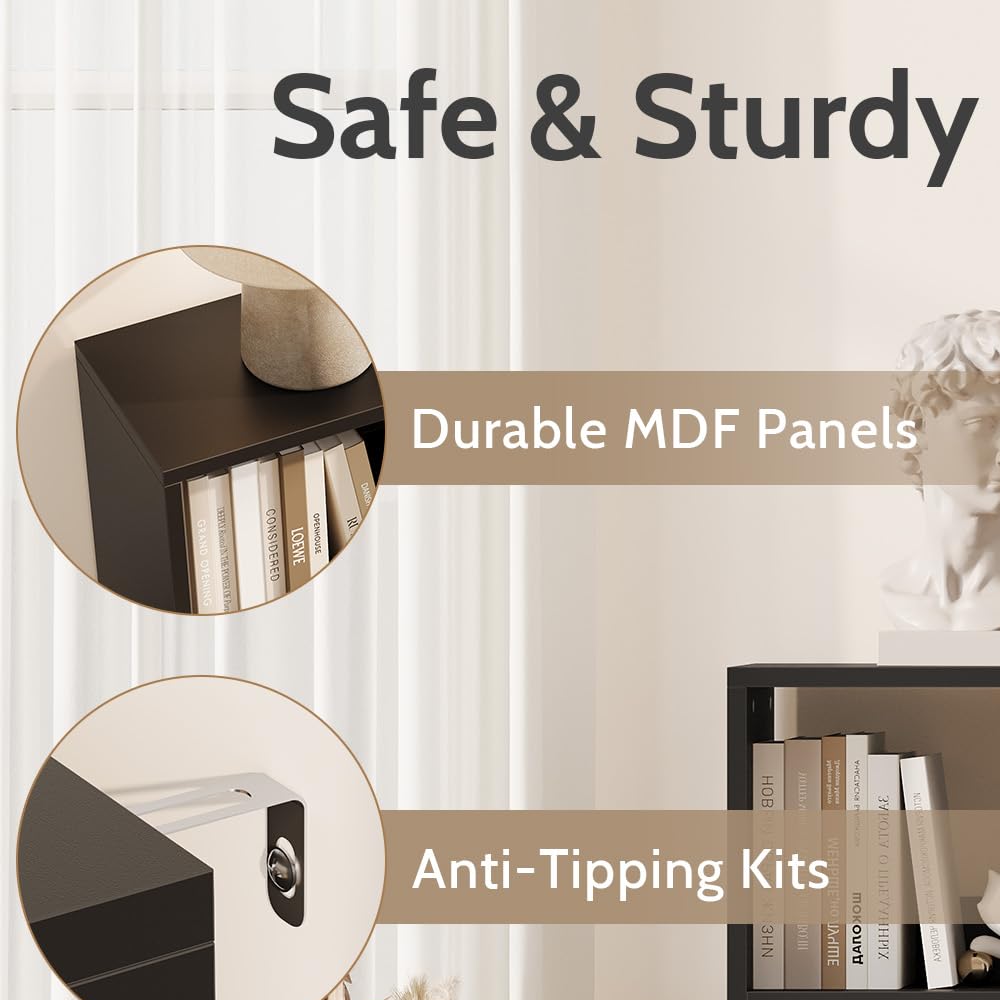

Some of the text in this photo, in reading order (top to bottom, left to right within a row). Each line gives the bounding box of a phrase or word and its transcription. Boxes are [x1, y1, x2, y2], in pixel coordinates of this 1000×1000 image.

[266, 509, 279, 582] CONSIDERED
[291, 528, 305, 565] LOEWE
[313, 513, 321, 554] OPENHOUSE
[197, 520, 212, 606] GRAND OPENING
